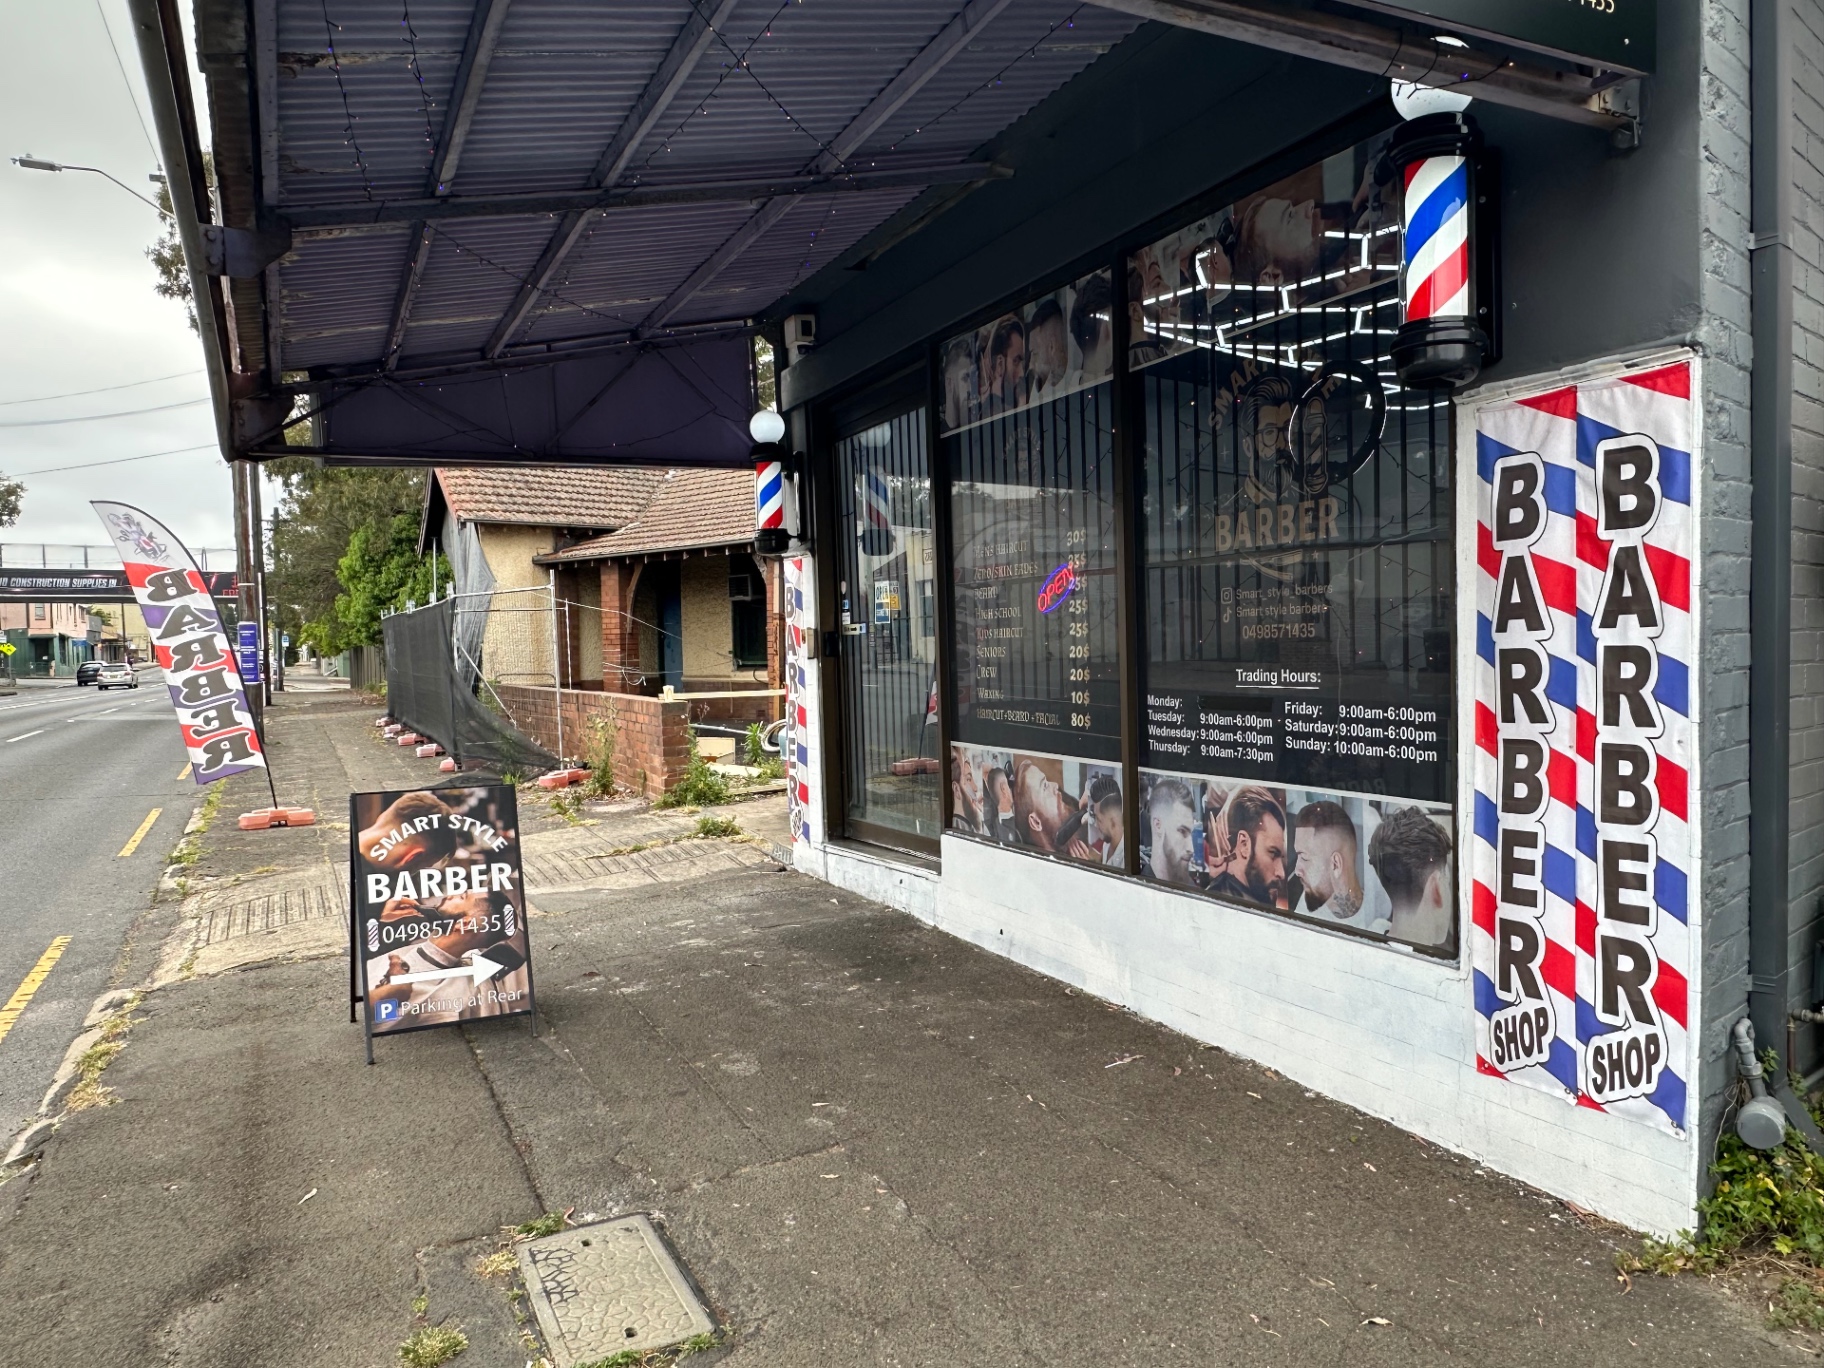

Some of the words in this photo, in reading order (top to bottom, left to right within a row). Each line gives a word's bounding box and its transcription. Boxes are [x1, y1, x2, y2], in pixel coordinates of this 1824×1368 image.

[1215, 498, 1339, 552] BARBER
[1066, 527, 1086, 547] 30$
[10, 577, 70, 588] CONSTRUCTION
[72, 578, 107, 588] SUPPLIES
[1038, 562, 1074, 612] OPEN
[1069, 597, 1088, 614] 25$
[1236, 607, 1263, 618] Smart
[1069, 620, 1089, 638] 25$
[1242, 622, 1316, 640] 0498571435
[1069, 643, 1090, 661] 20$
[1070, 666, 1090, 684] 20$
[1236, 668, 1278, 685] Trading
[1281, 668, 1321, 684] Hours:
[786, 587, 799, 807] BARBER
[1071, 689, 1090, 707] 10$
[1147, 694, 1183, 709] Monday:
[1071, 712, 1091, 730] 80$
[1147, 710, 1185, 724] Tuesday:
[1200, 712, 1273, 730] 9:00am-6:00pm
[1285, 701, 1323, 717] Friday:
[1339, 705, 1437, 723] 9:00am-6:00pm
[1148, 725, 1199, 740] Wednesday:
[1200, 728, 1273, 746] 9:00am-6:00pm
[1285, 718, 1339, 735] Saturday:
[1339, 724, 1437, 743] 9:00am-6:00pm
[1495, 461, 1545, 1002] BARBER
[1600, 445, 1659, 1029] BARBER
[1148, 739, 1190, 755] Thursday:
[1201, 744, 1274, 763] 9:00am-7:30pm
[1285, 735, 1331, 754] Sunday:
[1334, 740, 1438, 763] 10:00am-6:00pm
[370, 813, 442, 862] SMART
[448, 814, 508, 853] STYLE
[367, 862, 514, 904] BARBER
[382, 913, 501, 943] 0498571435
[401, 997, 464, 1016] Parking
[468, 992, 483, 1006] at
[488, 988, 523, 1003] Rear
[1494, 1010, 1550, 1068] SHOP
[1592, 1032, 1661, 1094] SHOP
